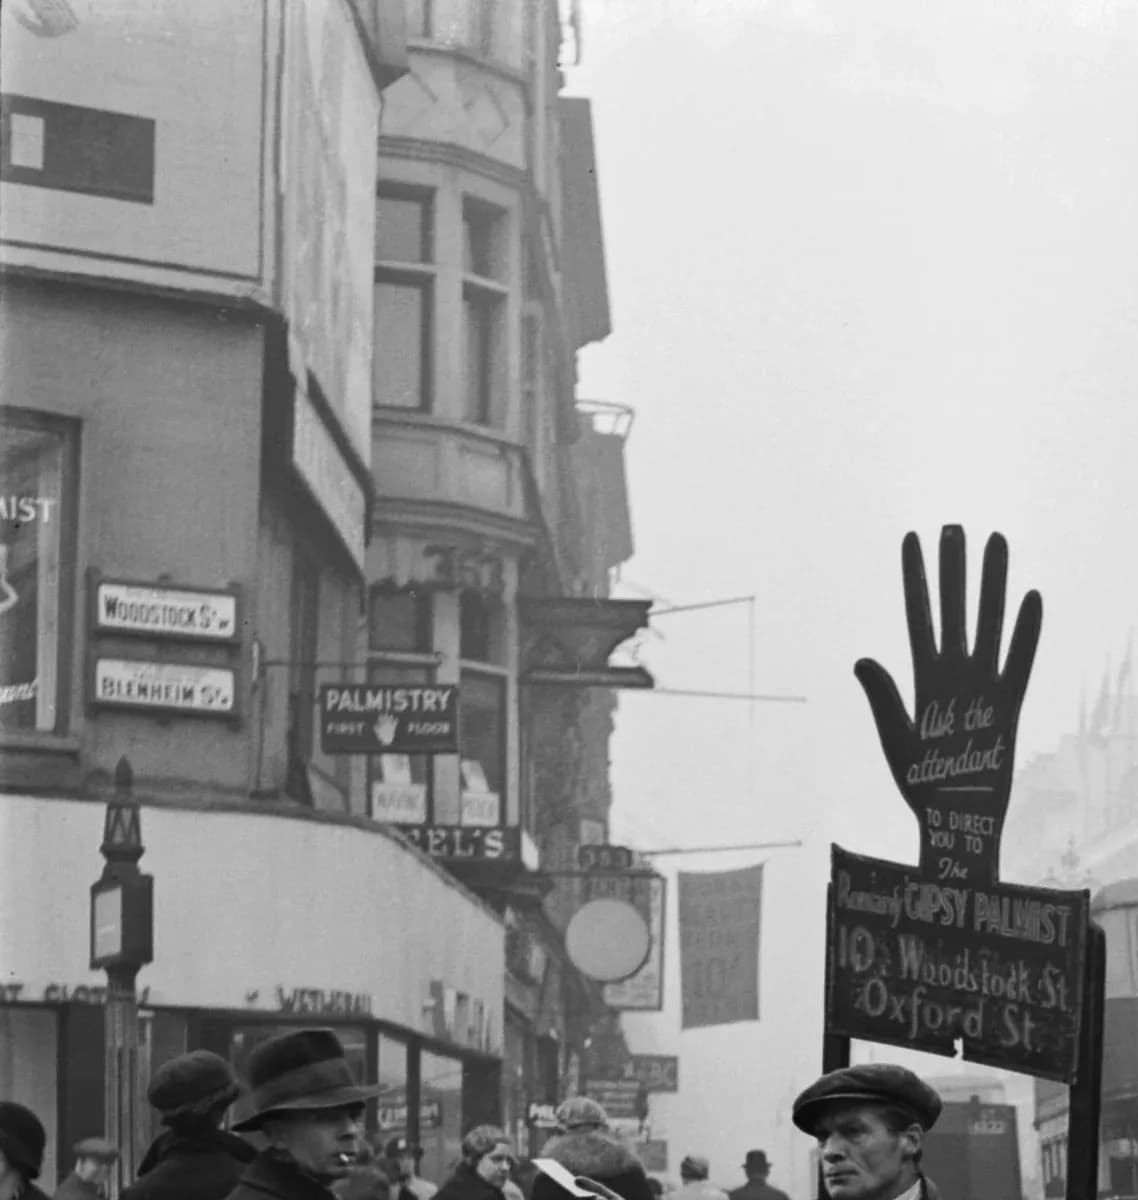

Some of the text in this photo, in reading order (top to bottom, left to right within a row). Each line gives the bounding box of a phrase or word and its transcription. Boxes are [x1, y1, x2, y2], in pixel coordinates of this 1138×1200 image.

[102, 676, 195, 706] BLENHEIM
[326, 688, 450, 713] PALMISTRY
[326, 721, 451, 735] FIRST FLOOR
[919, 697, 995, 740] Ask the
[906, 738, 1005, 785] attendant
[925, 807, 995, 836] TO DIRECT
[928, 829, 983, 855] YOU TO
[937, 856, 969, 880] The
[903, 882, 968, 928] GIPSY
[973, 892, 1072, 947] PALMIST
[862, 977, 985, 1041] Oxford
